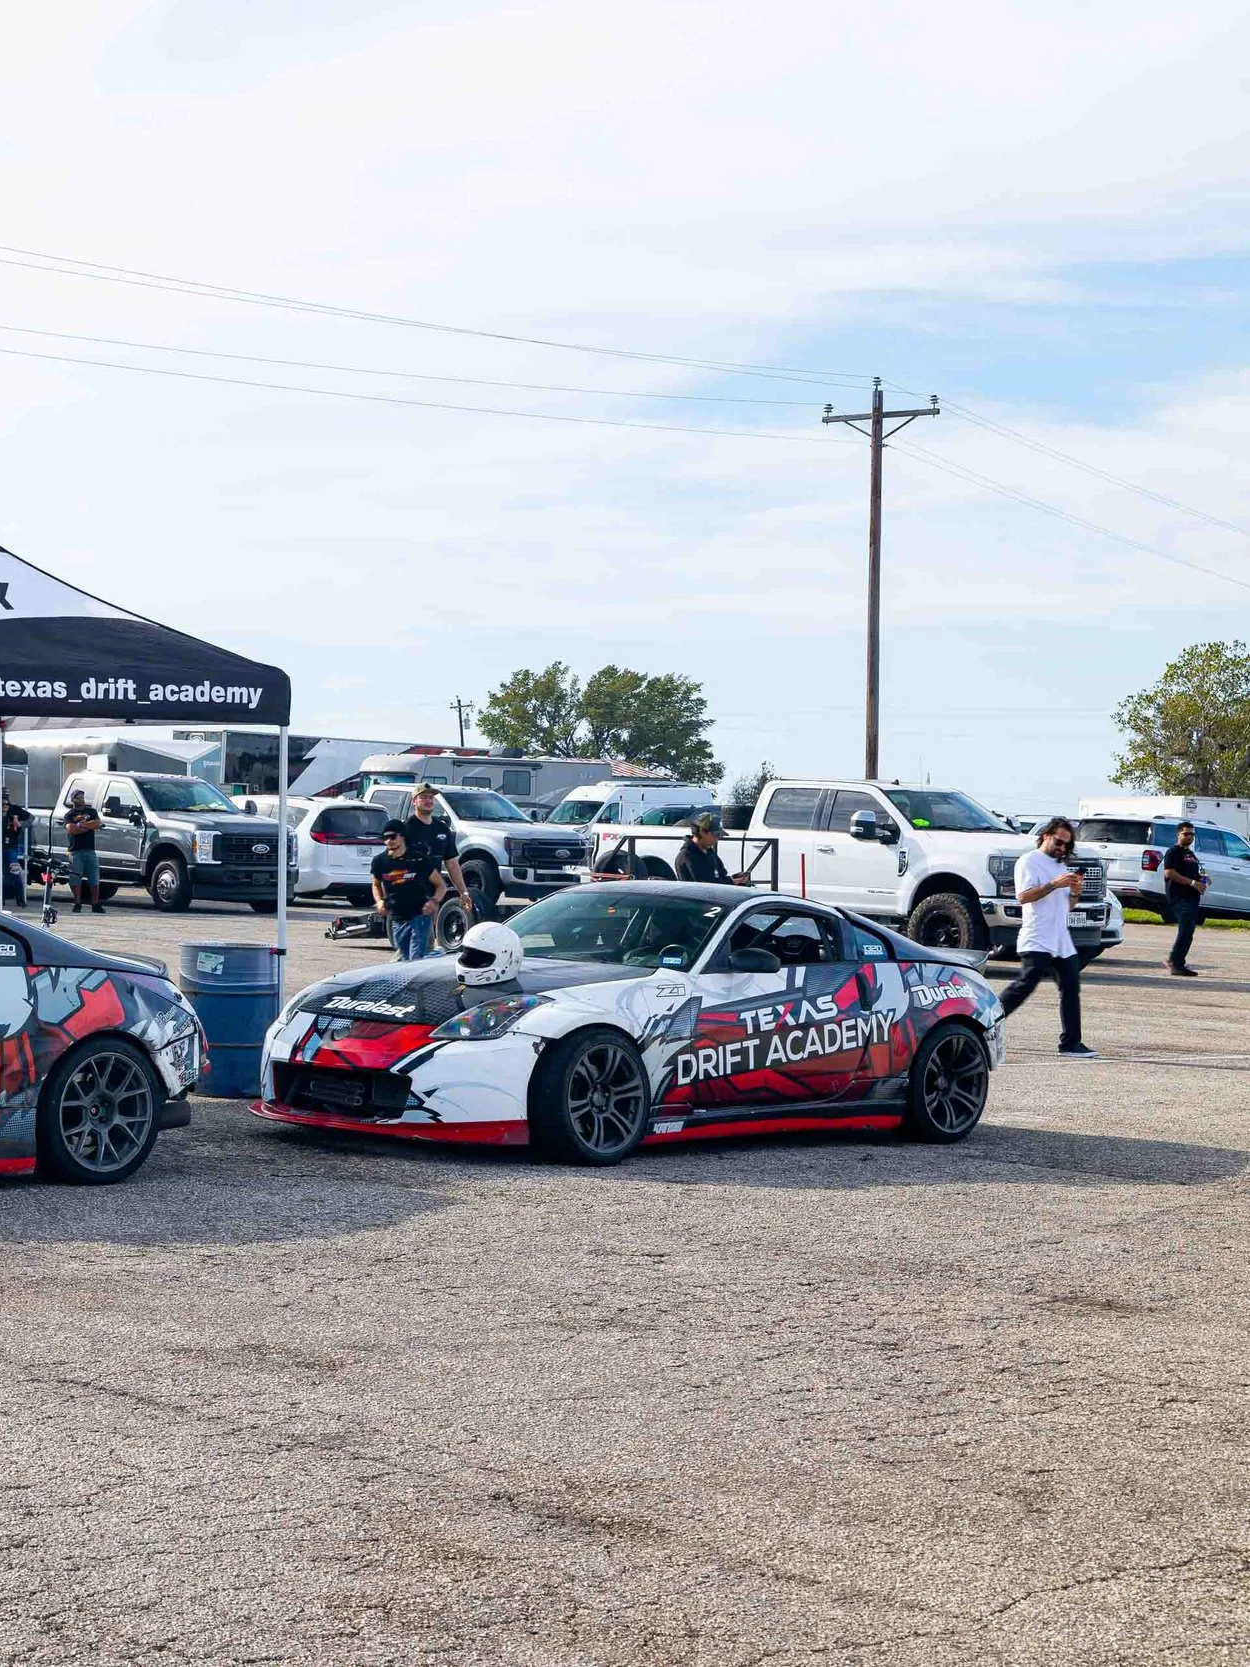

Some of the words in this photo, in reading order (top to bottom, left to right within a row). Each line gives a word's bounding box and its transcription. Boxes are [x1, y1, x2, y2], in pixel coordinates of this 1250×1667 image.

[703, 906, 721, 918] 2
[323, 996, 416, 1018] Duralast
[739, 995, 838, 1035] TEXAS
[677, 1038, 760, 1085] DRIFT
[766, 1011, 894, 1066] ACADEMY
